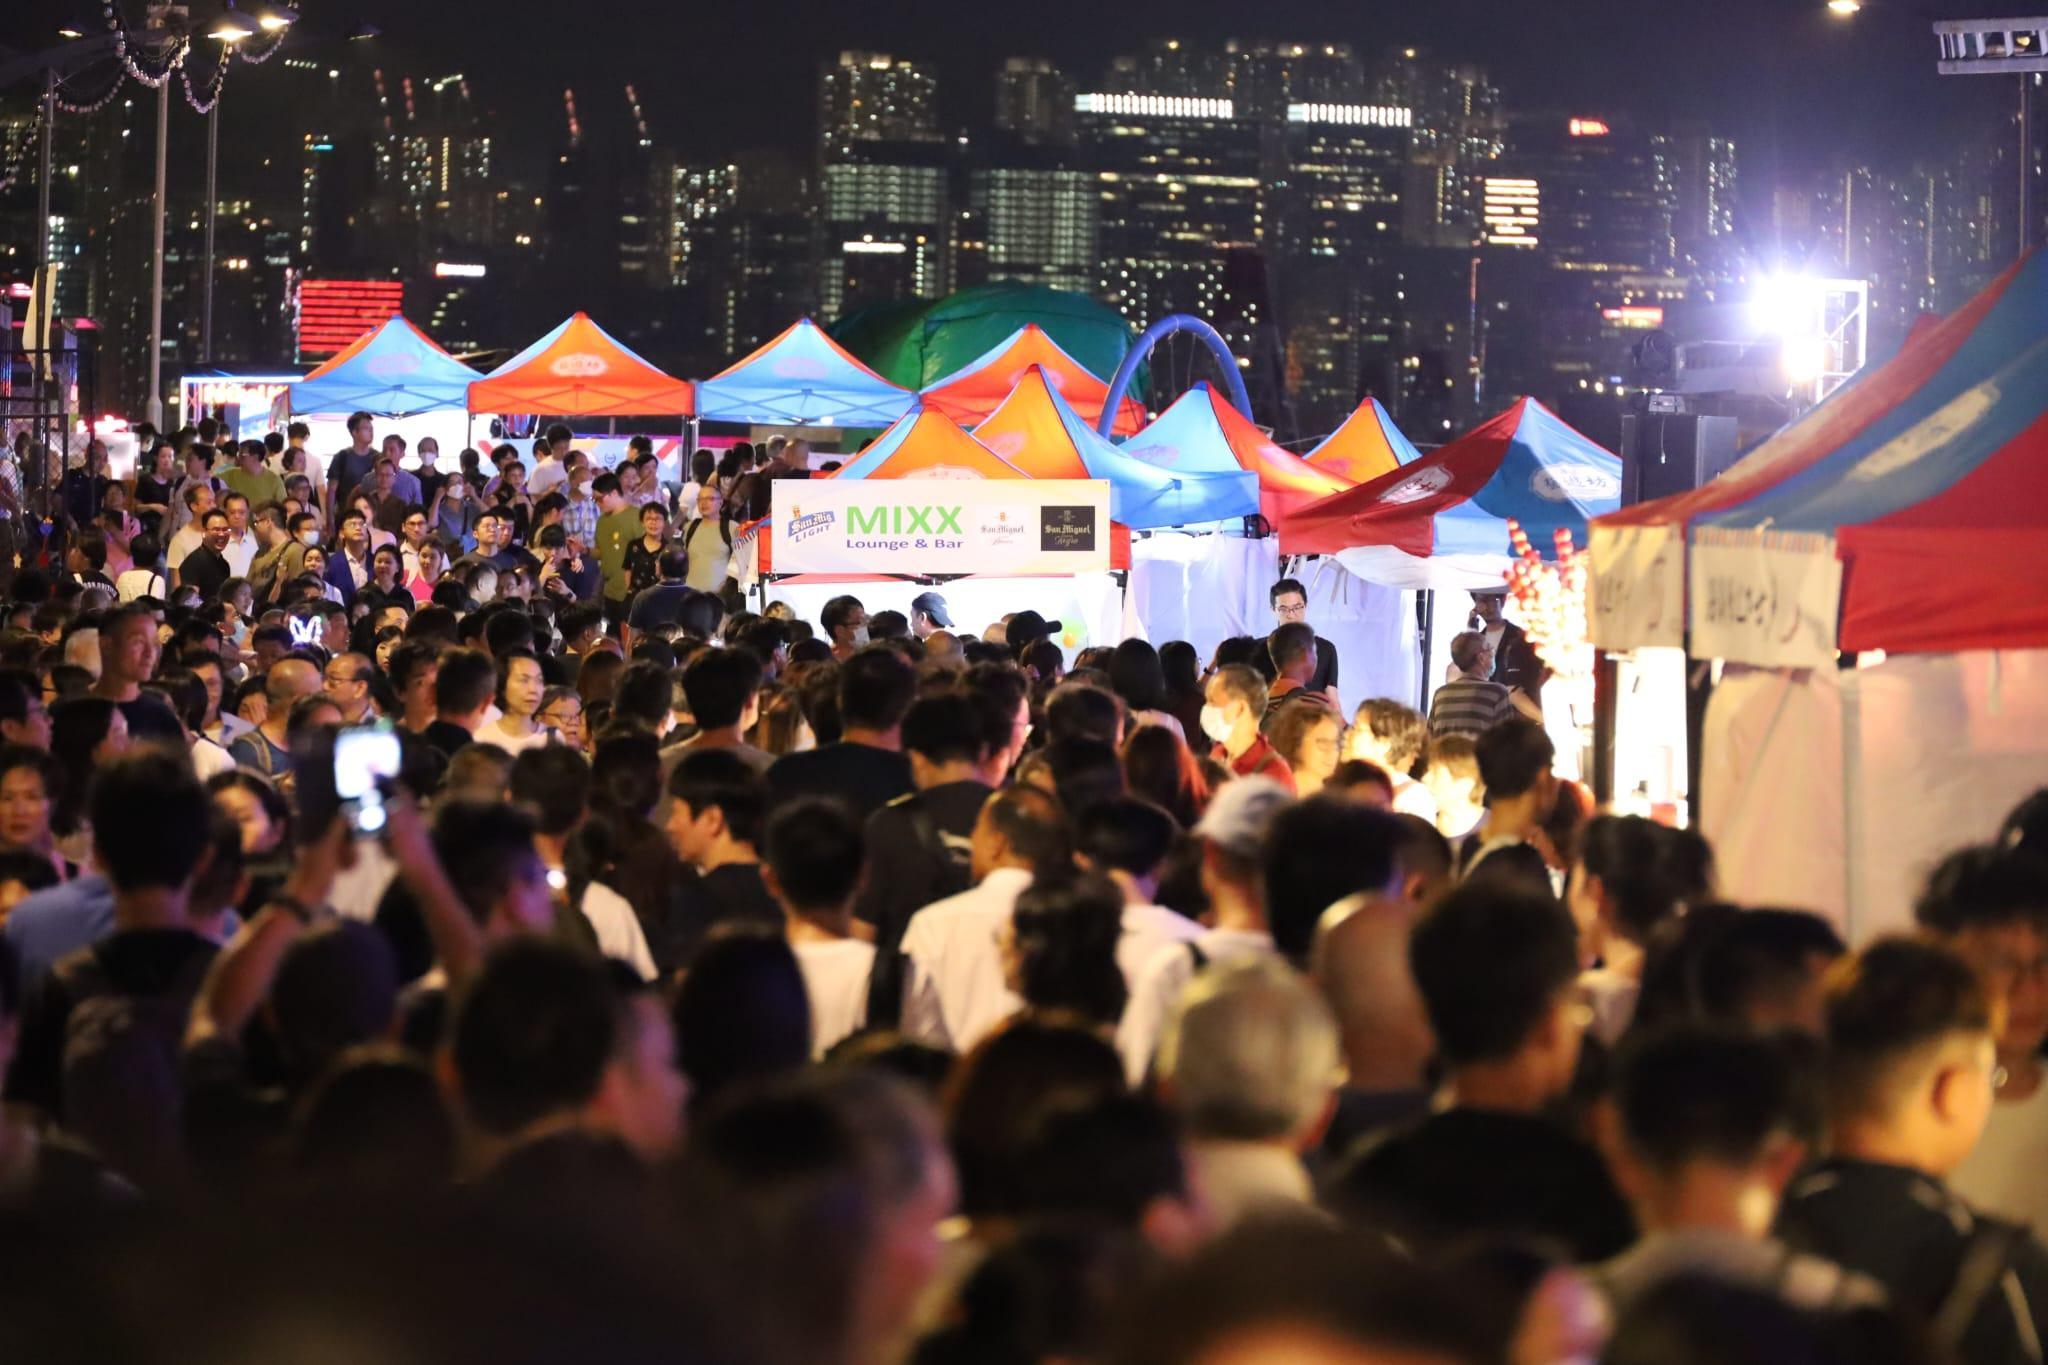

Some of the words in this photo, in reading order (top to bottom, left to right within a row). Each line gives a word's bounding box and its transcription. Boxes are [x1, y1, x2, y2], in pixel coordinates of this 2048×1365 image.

[846, 506, 963, 534] MIXX
[795, 524, 830, 543] LIGHT
[1044, 525, 1062, 534] San
[1061, 524, 1091, 535] Miguel
[846, 539, 909, 551] Lounge
[914, 538, 928, 549] &
[934, 539, 964, 549] Bar
